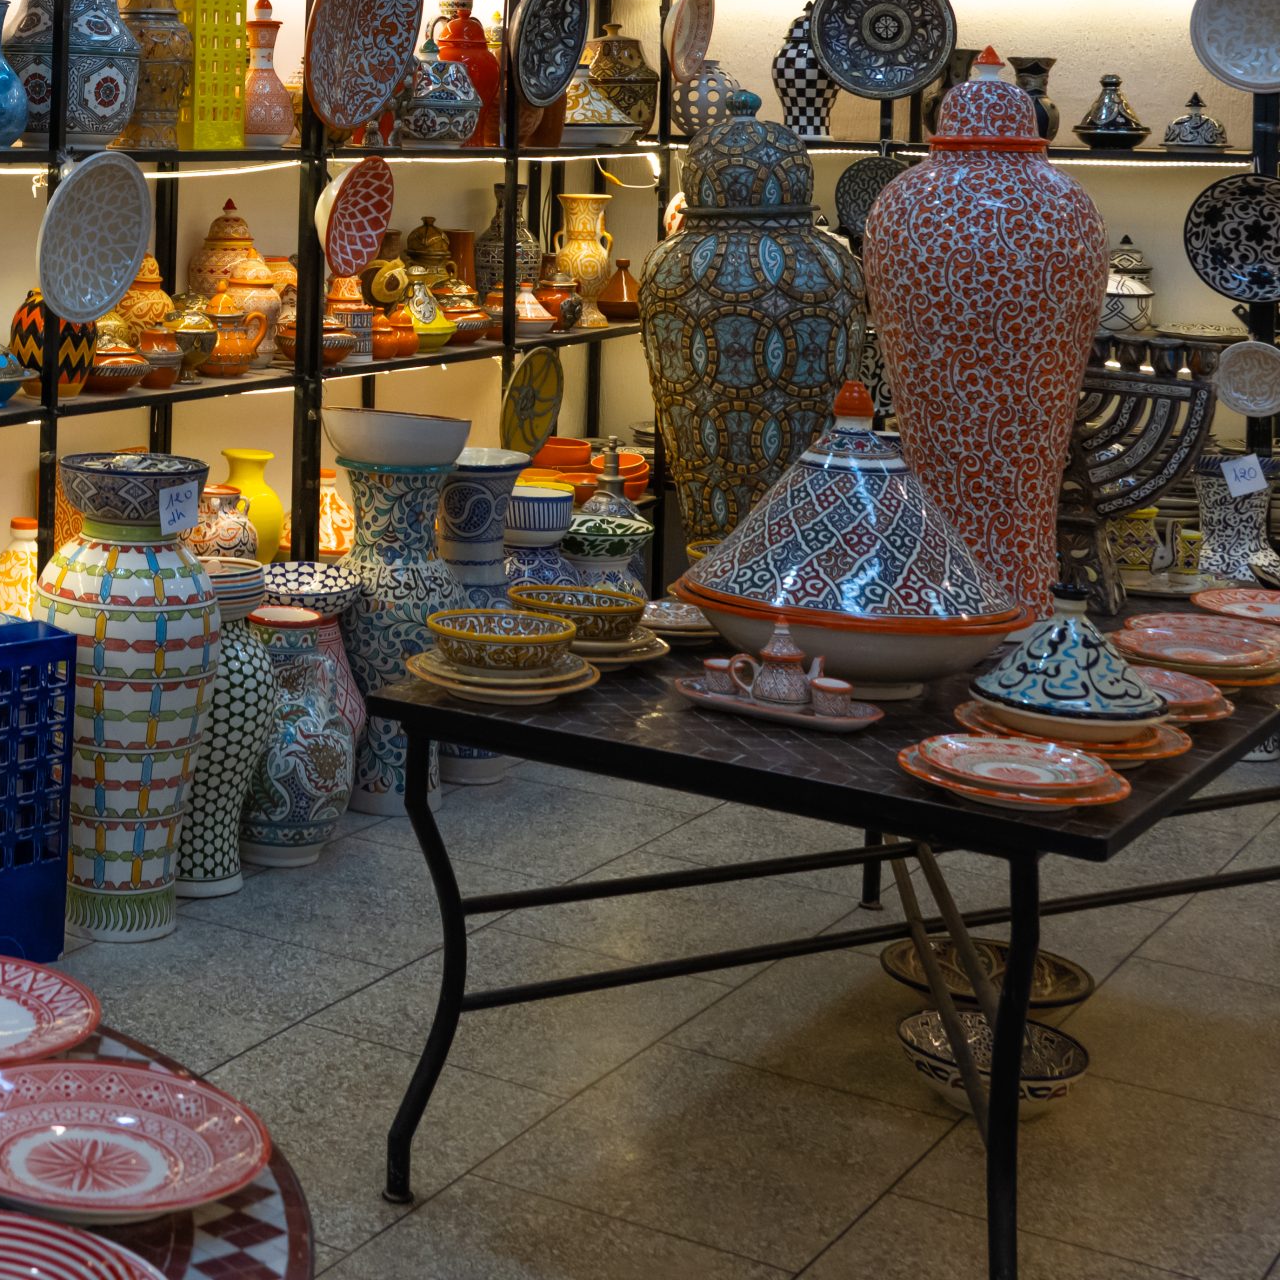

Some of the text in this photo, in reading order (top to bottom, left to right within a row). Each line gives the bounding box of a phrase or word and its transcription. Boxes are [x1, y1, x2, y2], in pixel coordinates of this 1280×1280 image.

[1232, 466, 1258, 483] 120
[164, 489, 193, 511] 120
[167, 508, 186, 527] dh
